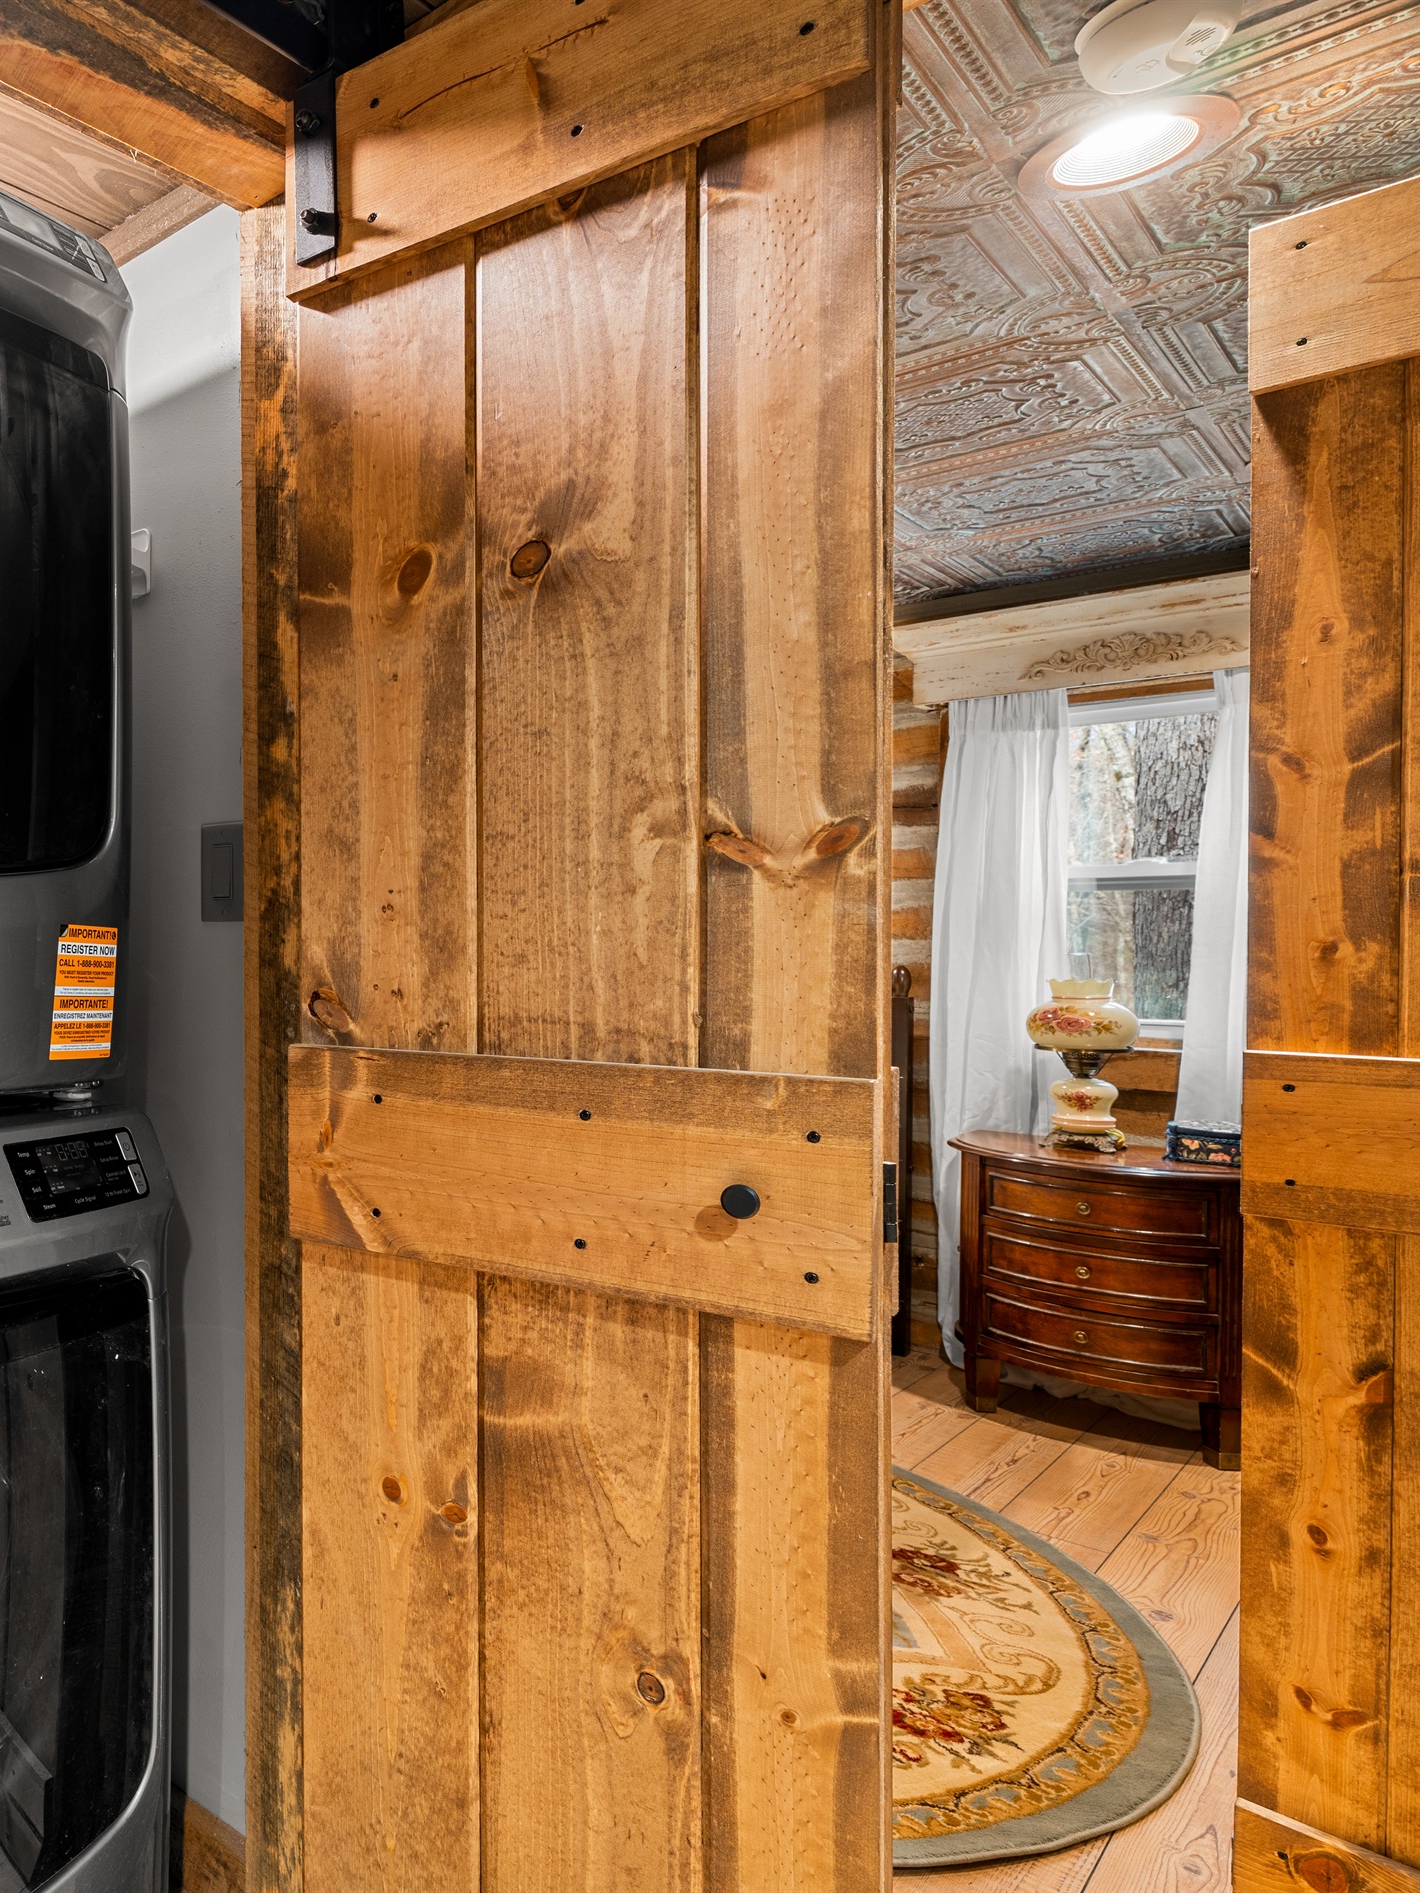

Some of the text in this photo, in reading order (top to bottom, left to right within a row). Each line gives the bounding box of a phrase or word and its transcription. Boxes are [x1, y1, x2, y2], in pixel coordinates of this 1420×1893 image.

[69, 928, 112, 940] IMPORTANT!
[60, 944, 116, 956] REGISTER NOW
[59, 958, 76, 967] CALL
[60, 999, 108, 1009] IMPORTANTE!
